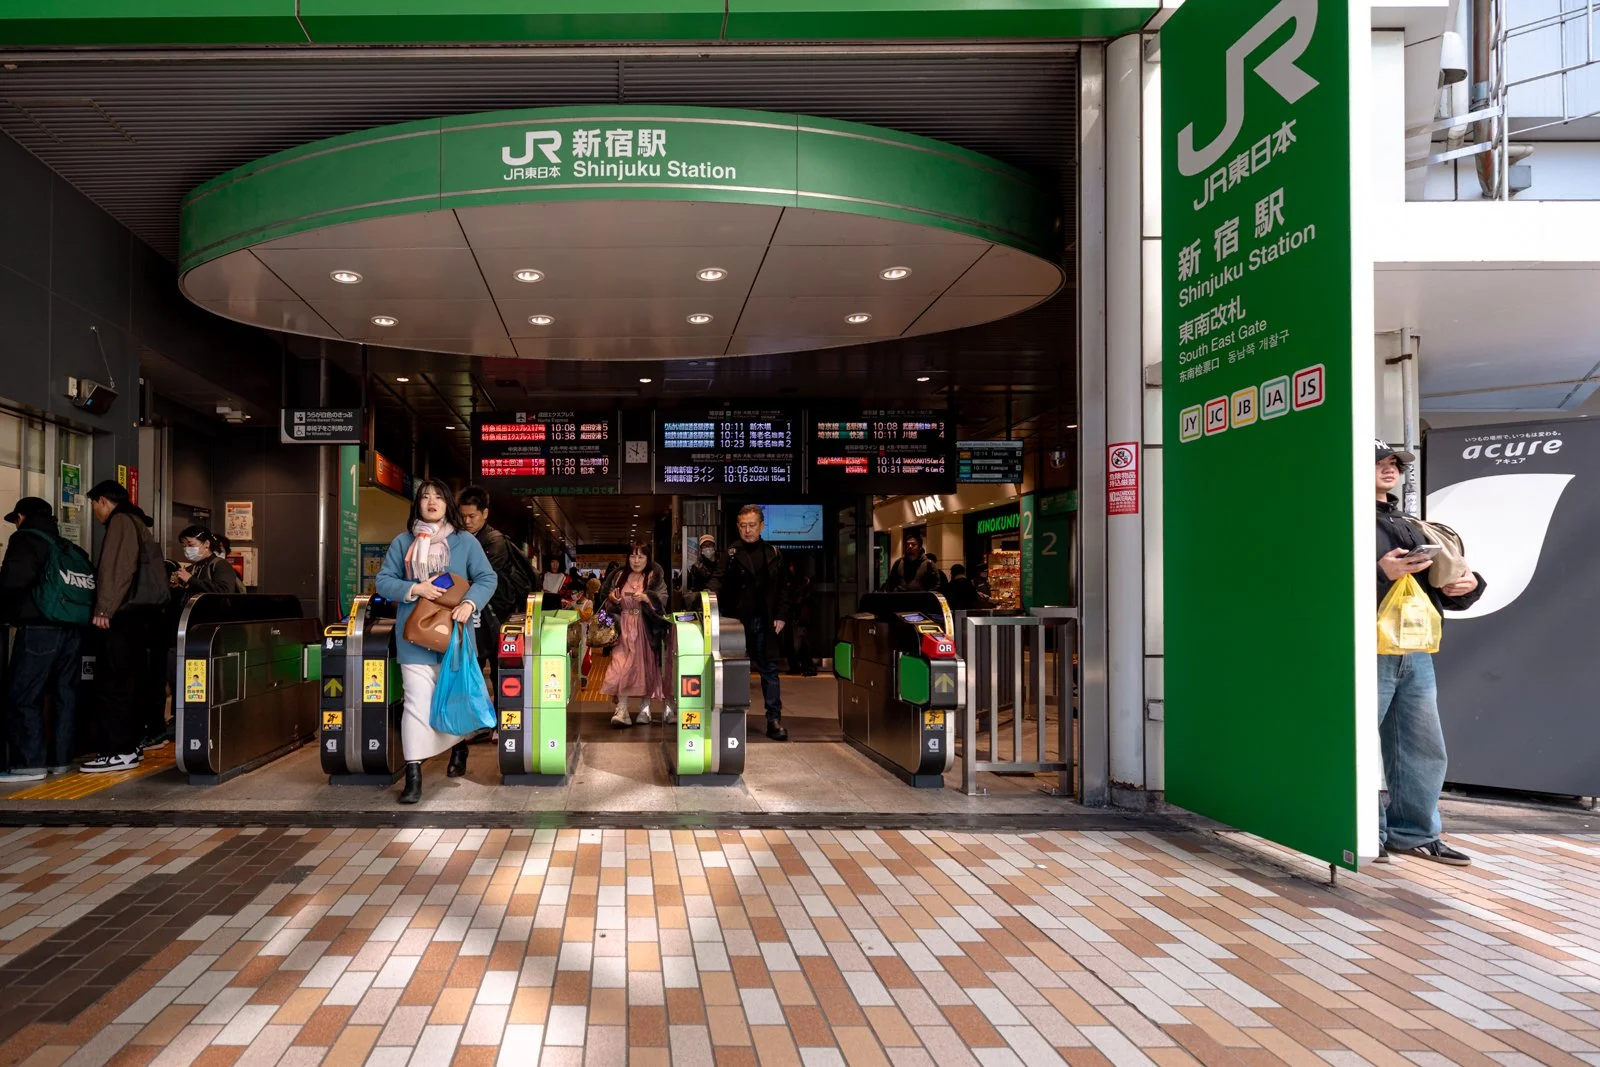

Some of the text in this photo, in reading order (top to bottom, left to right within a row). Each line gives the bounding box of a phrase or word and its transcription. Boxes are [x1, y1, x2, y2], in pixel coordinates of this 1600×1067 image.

[1178, 0, 1320, 176] JR
[502, 130, 562, 166] JR
[572, 129, 667, 158] 新宿駅
[503, 166, 561, 181] JR東日本
[573, 160, 736, 182] Shinjuku Station
[1193, 118, 1297, 211] JR東日本
[1178, 187, 1285, 282] 新宿駅
[1178, 223, 1316, 309] Shinjuku Station
[1178, 295, 1246, 346] 東南改札
[1179, 319, 1268, 366] South East Gate
[1227, 328, 1290, 364] 동남쪽 개찰구
[1300, 378, 1316, 398] JS
[1236, 399, 1251, 417] JB
[1266, 390, 1283, 408] JA
[1184, 416, 1197, 432] JY
[1209, 407, 1223, 425] JC
[551, 424, 576, 432] 10:08
[602, 424, 608, 432] 5
[720, 423, 744, 431] 10:11
[749, 423, 772, 431] 新木場
[786, 423, 791, 431] 1
[849, 431, 865, 439] 快速
[873, 431, 897, 439] 10:11
[902, 431, 918, 439] 川越
[938, 431, 945, 439] 4
[873, 422, 898, 430] 10:08
[938, 422, 945, 430] 3
[551, 432, 576, 440] 10:38
[602, 432, 608, 440] 5
[720, 431, 745, 440] 10:14
[785, 431, 791, 440] 2
[720, 440, 745, 448] 10:23
[785, 440, 791, 448] 2
[1465, 430, 1562, 442] いつもの場所で、いつもは変わる。
[1462, 439, 1563, 460] acure
[531, 459, 546, 467] 15号
[551, 458, 576, 467] 10:30
[602, 458, 610, 466] 10
[664, 466, 715, 474] 湘南新宿ライン
[724, 466, 748, 474] 10:05
[786, 466, 791, 474] 1
[876, 457, 901, 465] 10:14
[902, 457, 924, 465] TAKASAKI
[938, 457, 945, 465] 4
[876, 466, 900, 474] 10:31
[938, 466, 945, 474] 6
[1495, 457, 1526, 465] アキュア
[482, 466, 608, 476] 特急あずさ 17号 11:00 松本 9
[664, 474, 715, 483] 湘南新宿ライン
[724, 474, 749, 483] 10:16
[786, 474, 791, 482] 1
[350, 464, 356, 506] 1
[1023, 511, 1033, 539] 2
[1041, 532, 1058, 556] 2
[59, 569, 96, 592] VANS
[503, 643, 517, 652] QR
[938, 643, 953, 653] QR
[682, 678, 701, 696] IC
